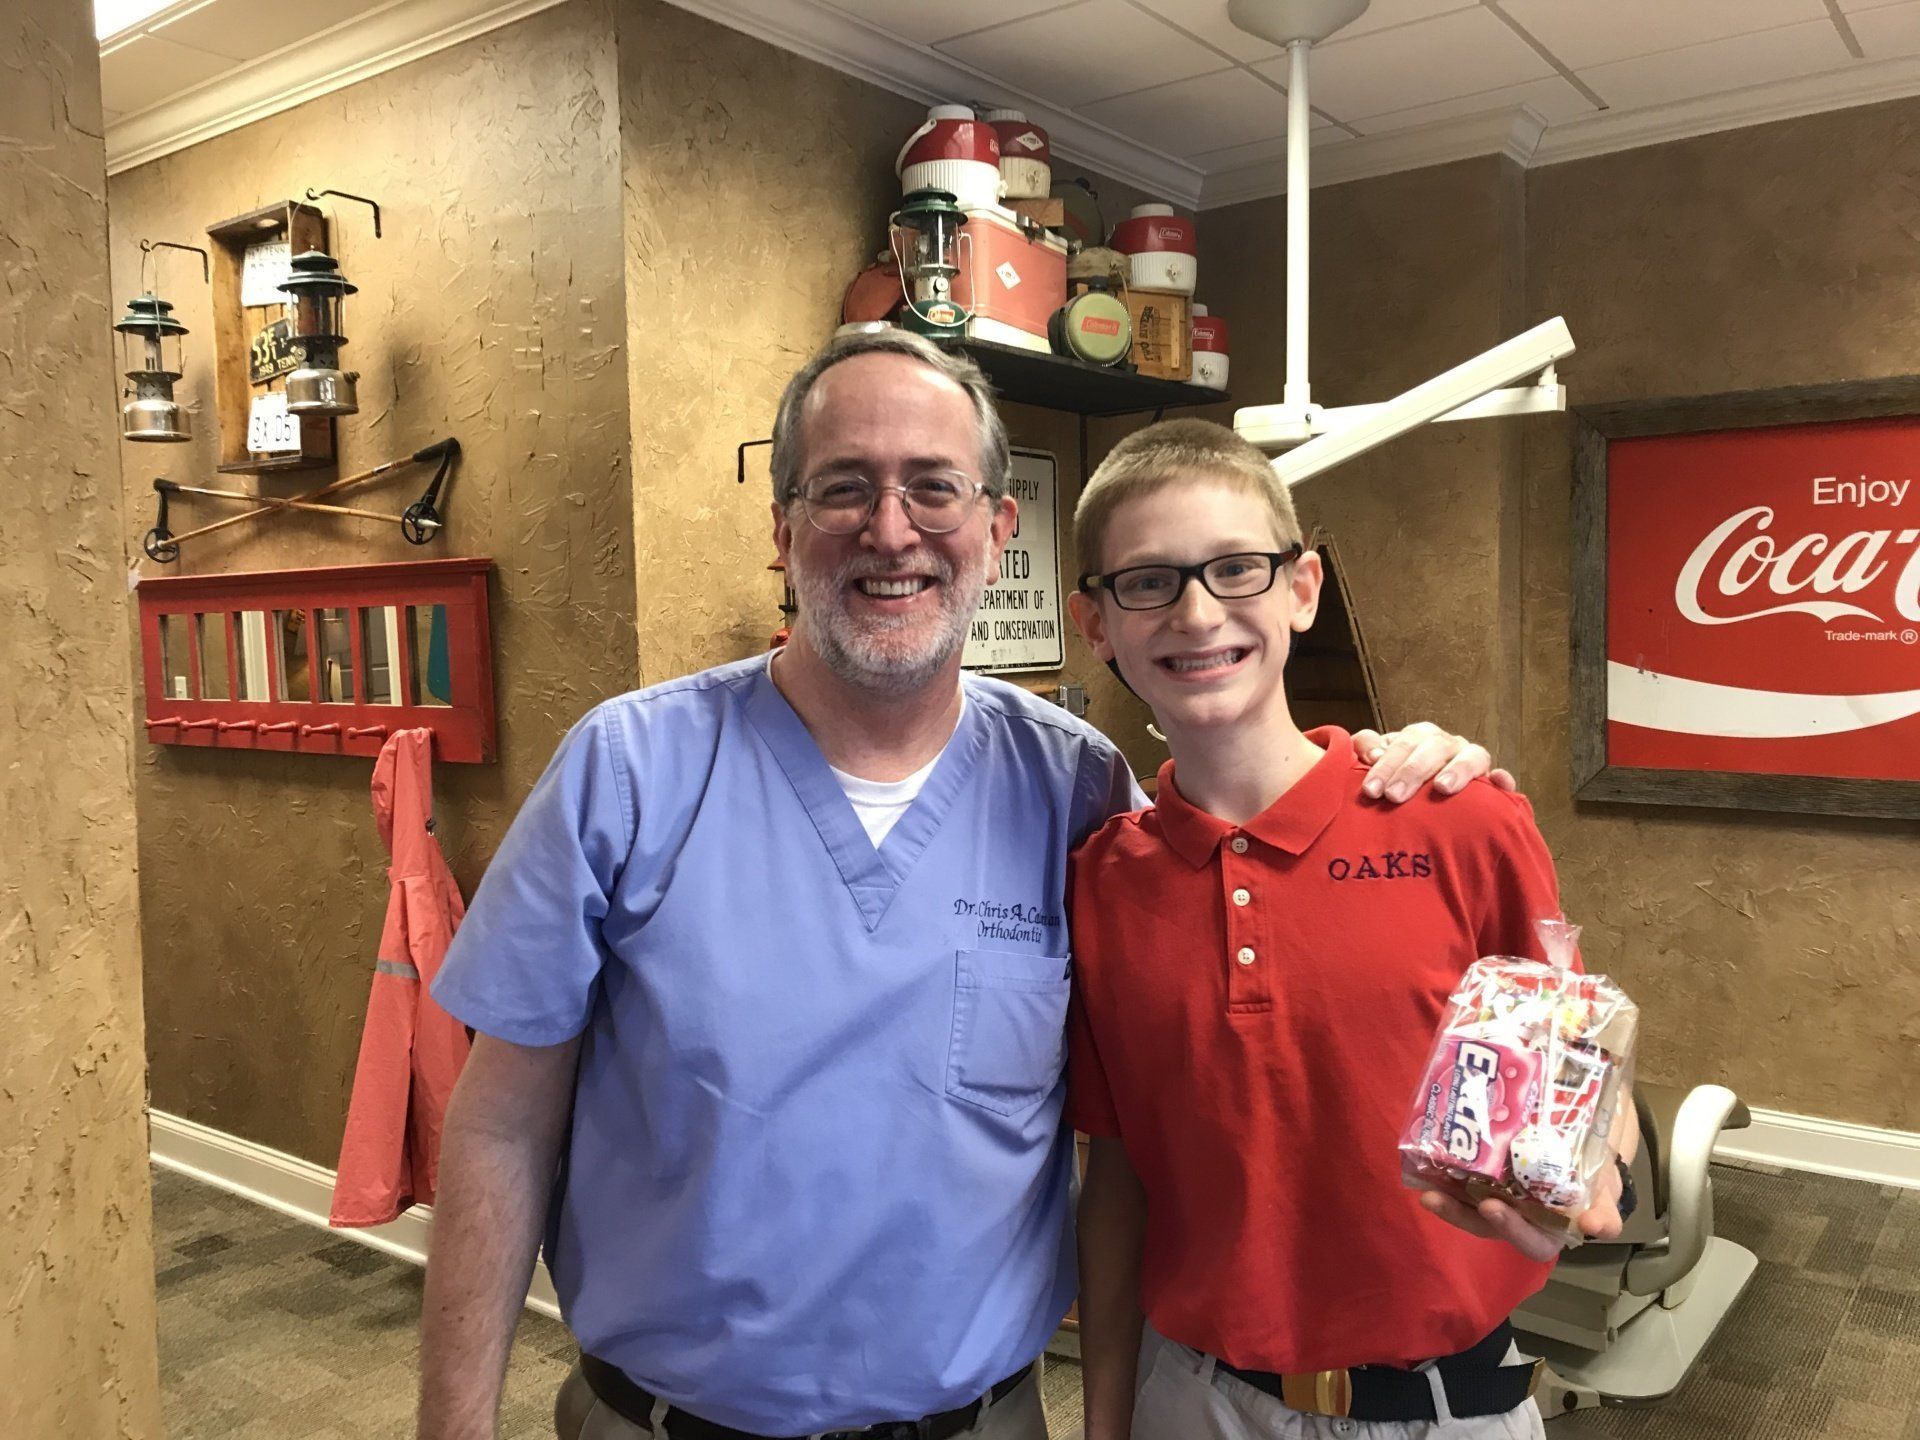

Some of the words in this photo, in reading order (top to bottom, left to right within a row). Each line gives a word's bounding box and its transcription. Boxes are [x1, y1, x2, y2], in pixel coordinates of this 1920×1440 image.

[1009, 479, 1039, 500] UPPLY
[1813, 474, 1910, 508] Enjoy
[980, 590, 1028, 610] PARTMENT
[1034, 591, 1044, 609] OF
[971, 621, 989, 641] AND
[994, 620, 1055, 641] CONSERVATION
[1824, 630, 1898, 642] Trade-mark
[1327, 851, 1432, 881] OAKS
[954, 898, 978, 916] Dr.
[979, 900, 1009, 920] Chris
[977, 920, 1042, 944] Orthodonti
[1426, 1083, 1441, 1120] CLASSIC
